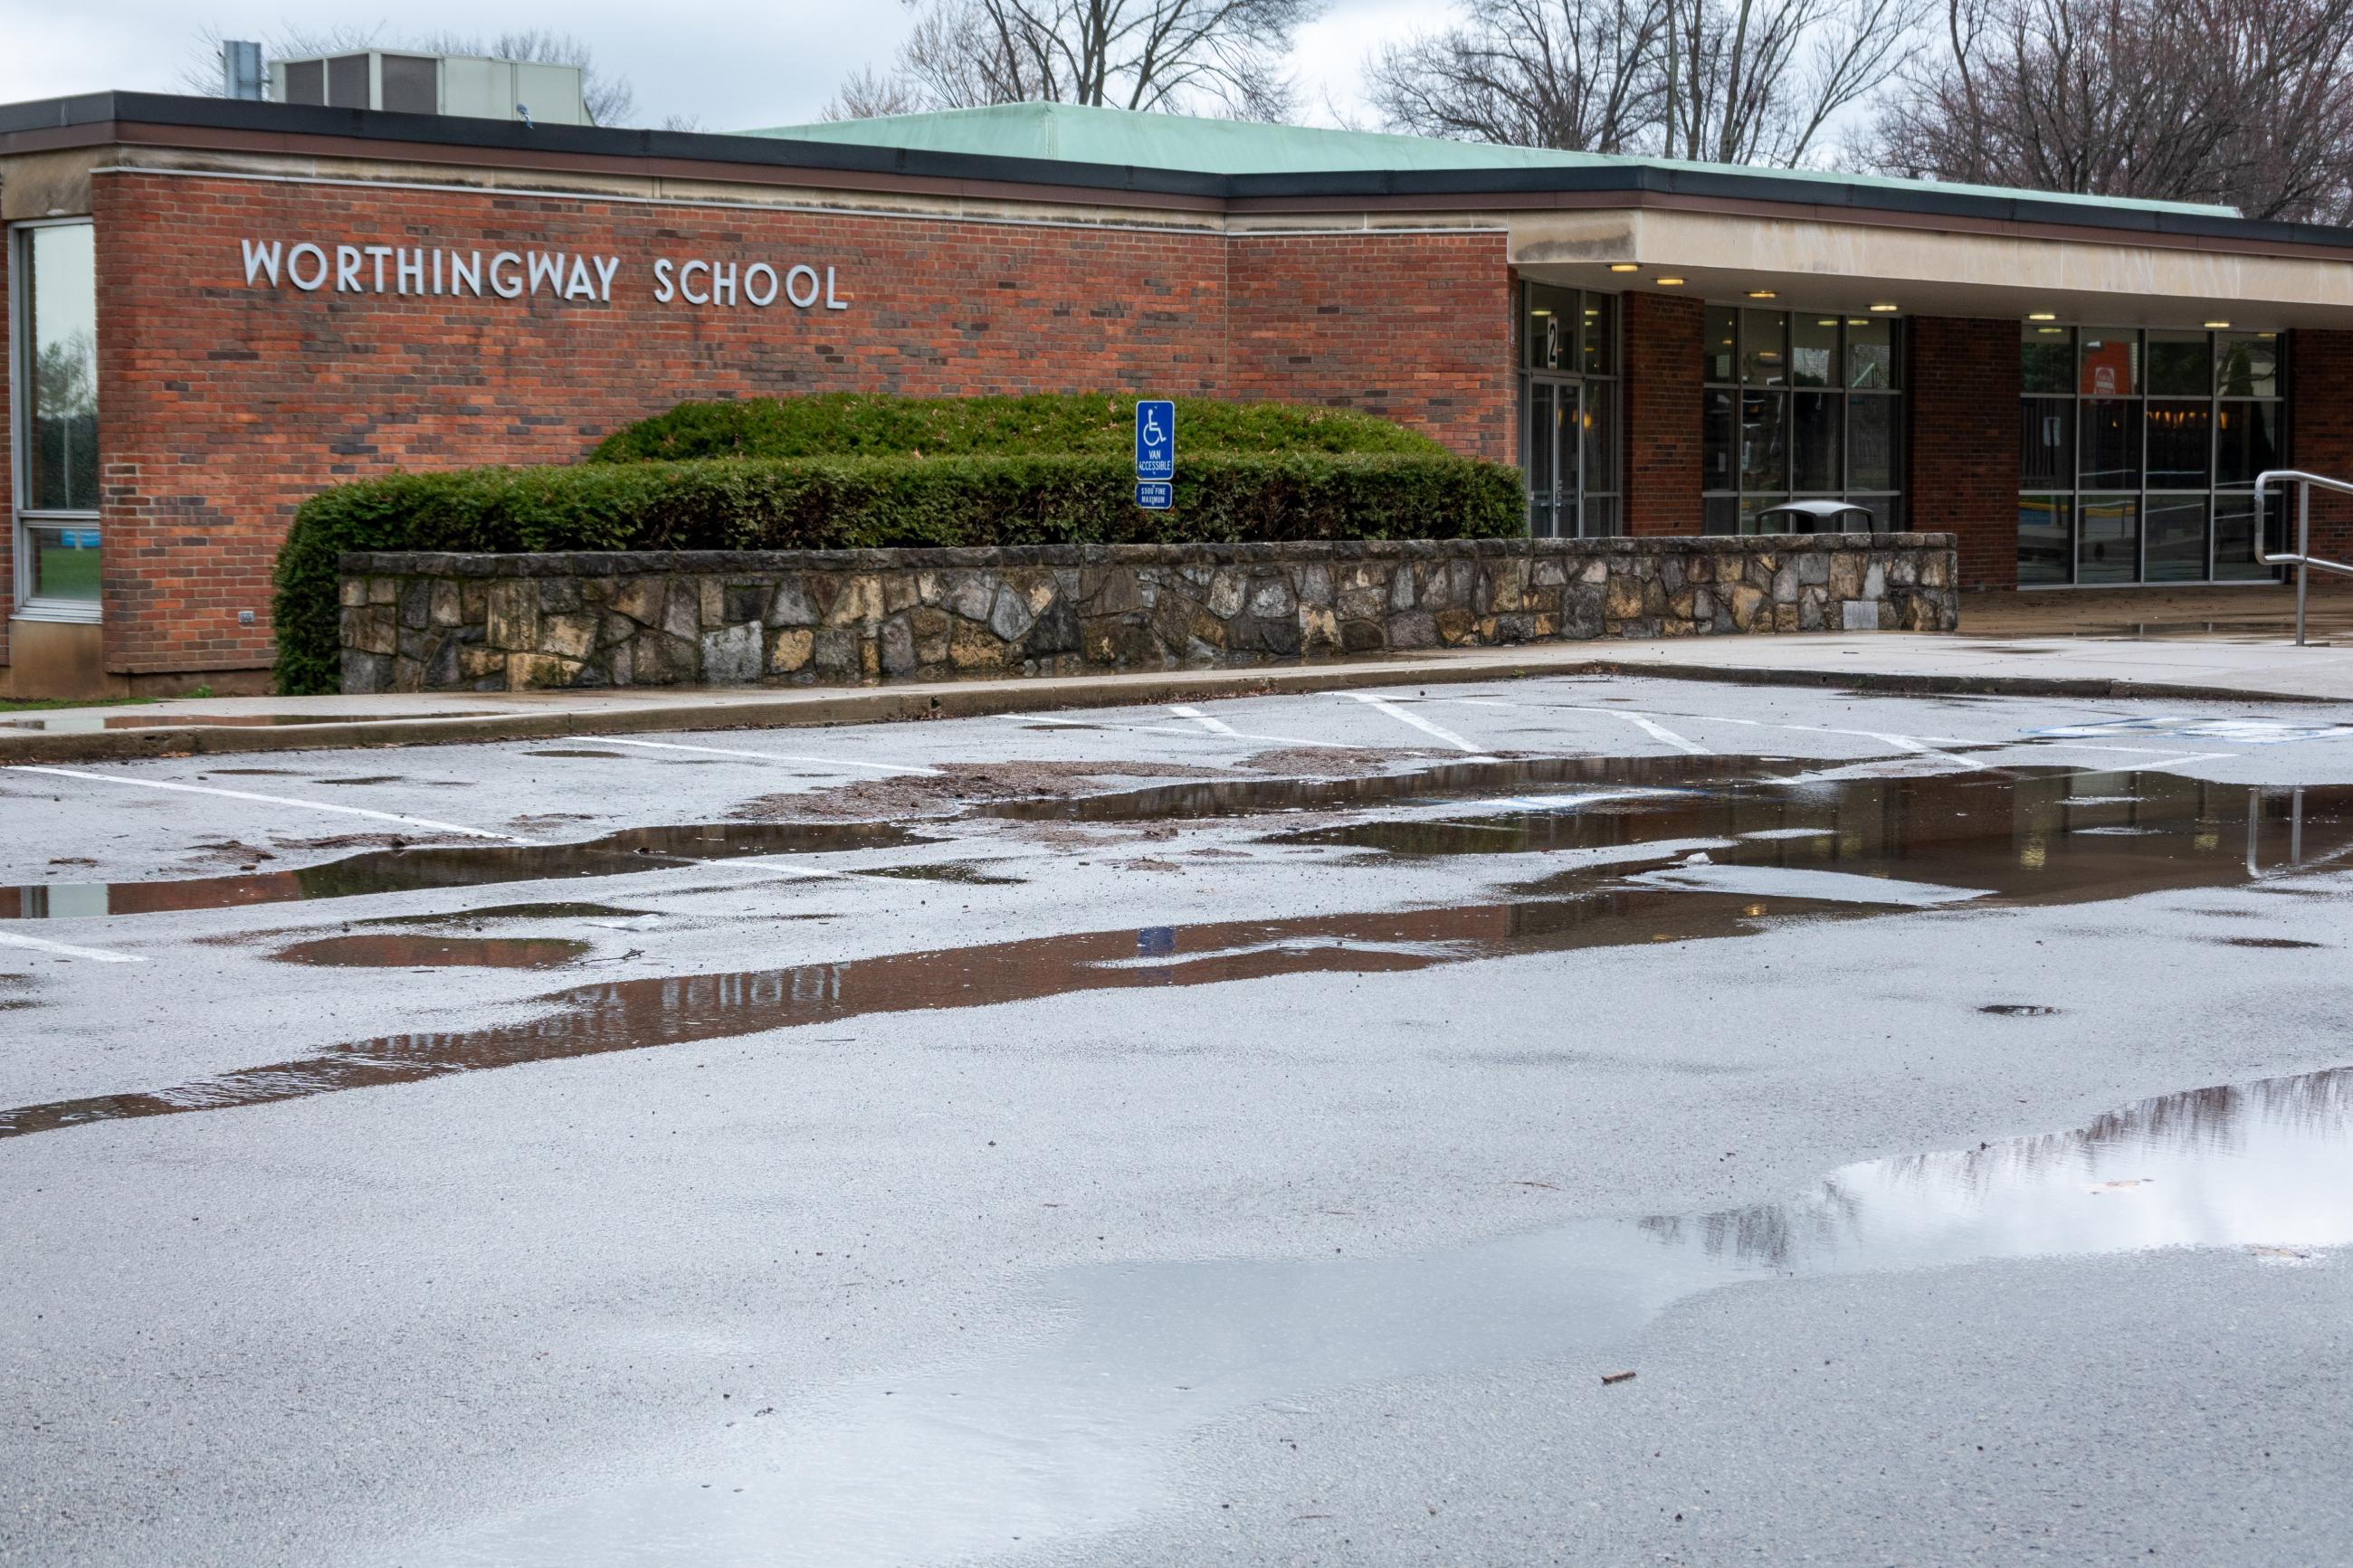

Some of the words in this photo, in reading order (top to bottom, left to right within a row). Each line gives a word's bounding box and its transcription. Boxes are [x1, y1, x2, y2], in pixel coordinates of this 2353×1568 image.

[242, 239, 620, 302] WORTHINGWAY
[653, 258, 848, 310] SCHOOL
[1548, 323, 1557, 363] 2
[1139, 461, 1171, 470] ACCESSIBLE
[1148, 450, 1161, 460] VAN
